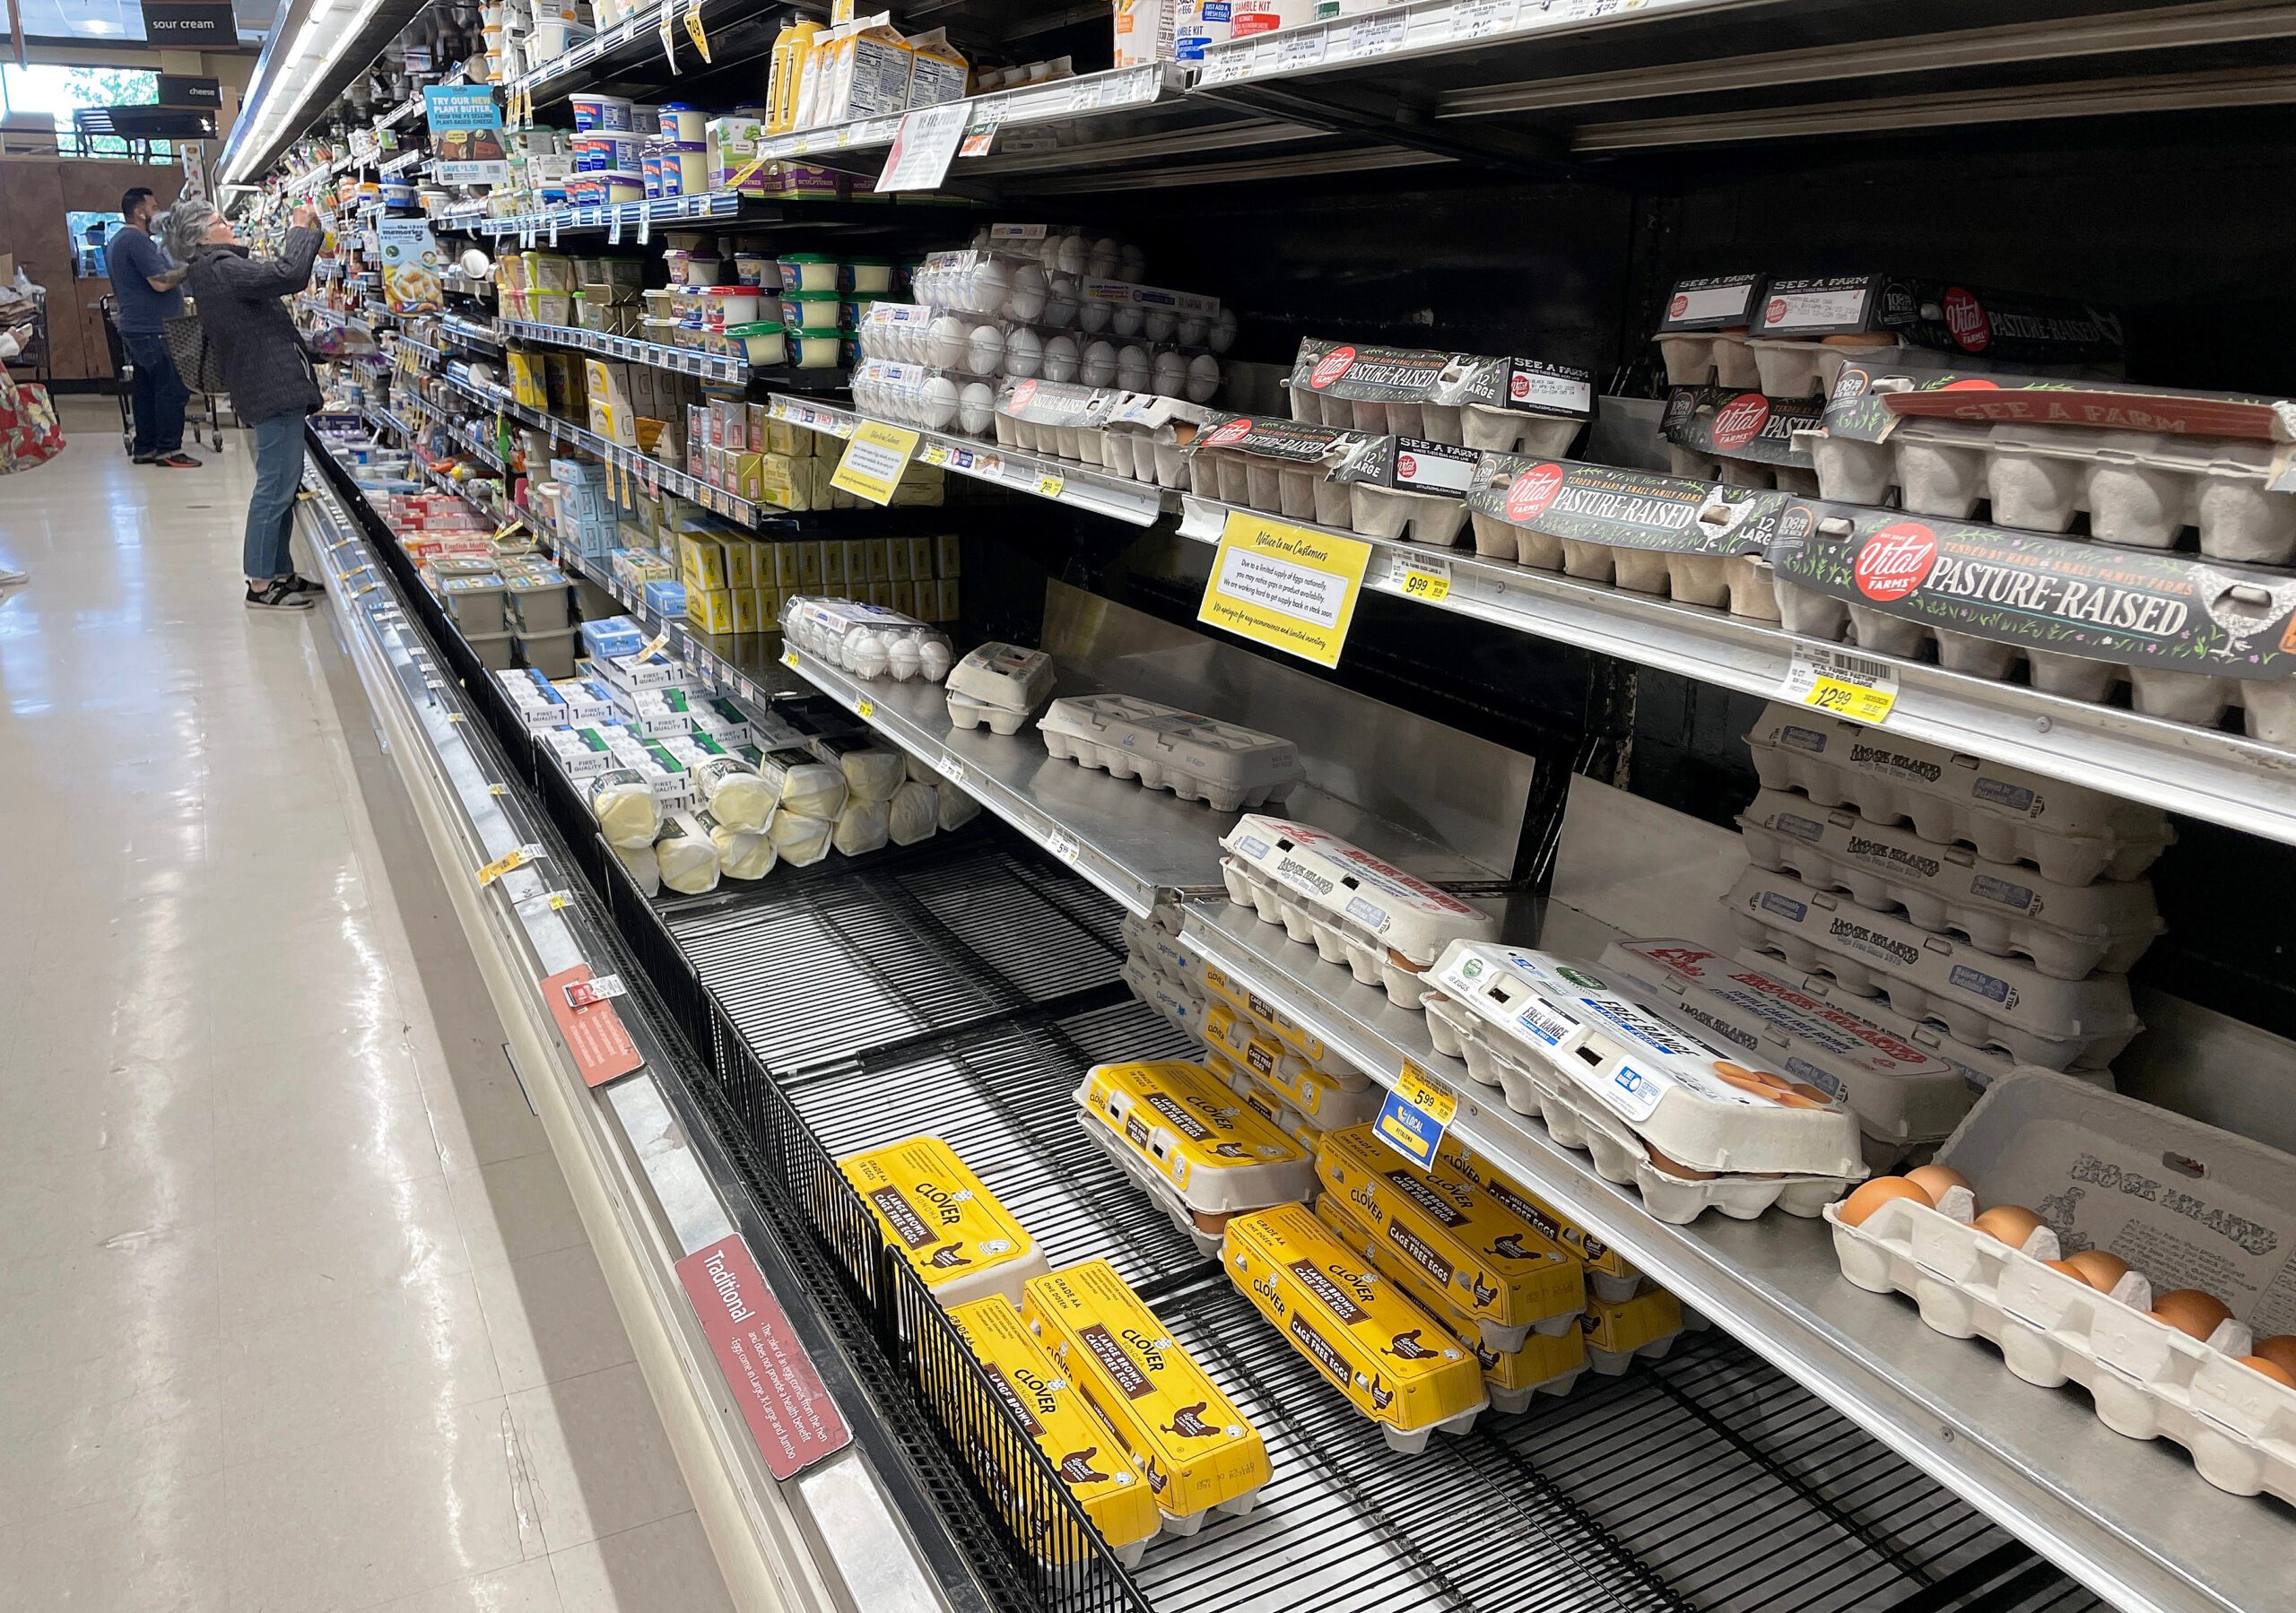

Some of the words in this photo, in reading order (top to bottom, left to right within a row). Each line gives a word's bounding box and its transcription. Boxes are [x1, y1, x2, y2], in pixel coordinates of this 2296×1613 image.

[1259, 2, 1271, 12] KIT
[152, 21, 177, 29] sour
[180, 21, 214, 29] cream
[1193, 26, 1204, 35] KIT
[857, 56, 871, 64] Calories
[875, 59, 881, 67] 25
[189, 88, 215, 96] cheese
[432, 97, 448, 105] TRY
[1679, 279, 1704, 288] SEE
[1707, 277, 1720, 285] A
[1723, 274, 1756, 283] FARM
[1774, 281, 1808, 290] SEE
[1828, 277, 1869, 286] FARM
[1946, 298, 1983, 334] Vital
[1987, 312, 2100, 342] PASTURE-RAISED
[1317, 351, 1352, 377] Vital
[1342, 362, 1438, 387] PASTURE-RAISED
[1514, 358, 1543, 369] SEE
[1560, 366, 1588, 377] FARM
[1464, 383, 1495, 400] LARGE
[1478, 374, 1489, 385] 12
[1716, 403, 1766, 434] Vital
[1955, 403, 2035, 420] SEE
[2048, 403, 2074, 420] A
[2083, 406, 2188, 433] FARM
[1400, 438, 1430, 449] SEE
[1434, 445, 1444, 453] A
[1448, 447, 1479, 459] FARM
[1719, 433, 1749, 444] FARMS
[1350, 460, 1382, 478] LARGE
[1363, 451, 1376, 464] 12
[1512, 472, 1561, 504] Vital
[1551, 486, 1697, 531] PASTURE-RAISED
[1256, 531, 1276, 549] Notice
[1276, 537, 1283, 549] to
[1292, 540, 1328, 561] Customers
[1859, 534, 1935, 576] Vital
[1241, 559, 1250, 567] Due
[1259, 564, 1274, 576] limited
[1274, 569, 1287, 581] supply
[1292, 575, 1305, 585] Eggs
[1943, 542, 1985, 559] TENDED
[1987, 548, 2005, 560] BY
[2007, 551, 2039, 568] HAND
[2050, 559, 2093, 578] SMALL
[2098, 567, 2147, 586] FAMILY
[2148, 576, 2196, 595] FARMS
[1245, 574, 1255, 583] may
[1256, 577, 1268, 585] notice
[1268, 581, 1278, 590] gaps
[1283, 585, 1300, 595] product
[1300, 589, 1325, 603] availability.
[1867, 577, 1909, 591] FARMS
[1924, 555, 2189, 637] PASTURE-RAISED
[1238, 585, 1255, 595] working
[1256, 587, 1266, 597] hard
[1270, 594, 1278, 602] get
[1277, 595, 1292, 607] supply
[1292, 599, 1304, 610] back
[1309, 605, 1321, 616] stock
[1813, 669, 1834, 679] RAISED
[1836, 674, 1851, 683] EGGS
[1853, 679, 1873, 688] LARGE
[1829, 666, 1848, 675] FARMS
[1850, 670, 1877, 683] PASTURE
[646, 721, 652, 733] 1
[683, 717, 689, 729] 1
[1830, 917, 1871, 941] ROCK
[1868, 932, 1918, 966] ISLAND
[1207, 1024, 1225, 1041] CLOVER
[1521, 1006, 1544, 1026] FREE
[1541, 1016, 1570, 1040] RANGE
[1596, 1000, 1647, 1026] FREE
[1633, 1023, 1700, 1057] RANGE
[1414, 1089, 1435, 1107] 599
[1396, 1127, 1413, 1143] PETALUMA
[1406, 1114, 1423, 1133] LOCAL
[886, 1193, 908, 1215] LARGE
[903, 1212, 927, 1236] BROWN
[915, 1183, 961, 1226] CLOVER
[1350, 1188, 1384, 1226] CLOVER
[875, 1194, 892, 1212] CAGE
[888, 1210, 904, 1229] FREE
[900, 1225, 919, 1244] EGGS
[1389, 1226, 1412, 1246] CAGE
[1408, 1243, 1431, 1265] FREE
[1427, 1260, 1449, 1284] EGGS
[703, 1250, 756, 1323] Traditional
[1293, 1267, 1315, 1288] CAGE
[1312, 1284, 1333, 1304] FREE
[1330, 1300, 1352, 1320] EGGS
[1306, 1266, 1331, 1290] LARGE
[1328, 1288, 1358, 1314] BROWN
[1327, 1264, 1375, 1303] CLOVER
[731, 1339, 744, 1355] Eggs
[748, 1331, 761, 1343] and
[754, 1343, 767, 1358] does
[1097, 1332, 1122, 1360] LARGE
[1116, 1356, 1144, 1385] BROWN
[1121, 1329, 1165, 1373] CLOVER
[739, 1354, 752, 1372] come
[747, 1370, 756, 1378] in
[762, 1357, 772, 1369] not
[1084, 1333, 1106, 1357] CAGE
[1100, 1352, 1121, 1376] FREE
[1115, 1369, 1137, 1393] EGGS
[751, 1376, 764, 1398] Large,
[761, 1323, 771, 1337] The
[767, 1336, 779, 1351] color
[778, 1358, 787, 1367] an
[783, 1366, 795, 1380] egg
[789, 1379, 805, 1401] comes
[801, 1398, 813, 1417] from
[809, 1416, 821, 1428] the
[815, 1427, 827, 1442] hen
[765, 1369, 785, 1392] provide
[761, 1394, 778, 1423] X-Large
[782, 1395, 799, 1418] health
[772, 1421, 787, 1435] and
[792, 1416, 811, 1443] benefit
[778, 1435, 796, 1459] Jumbo
